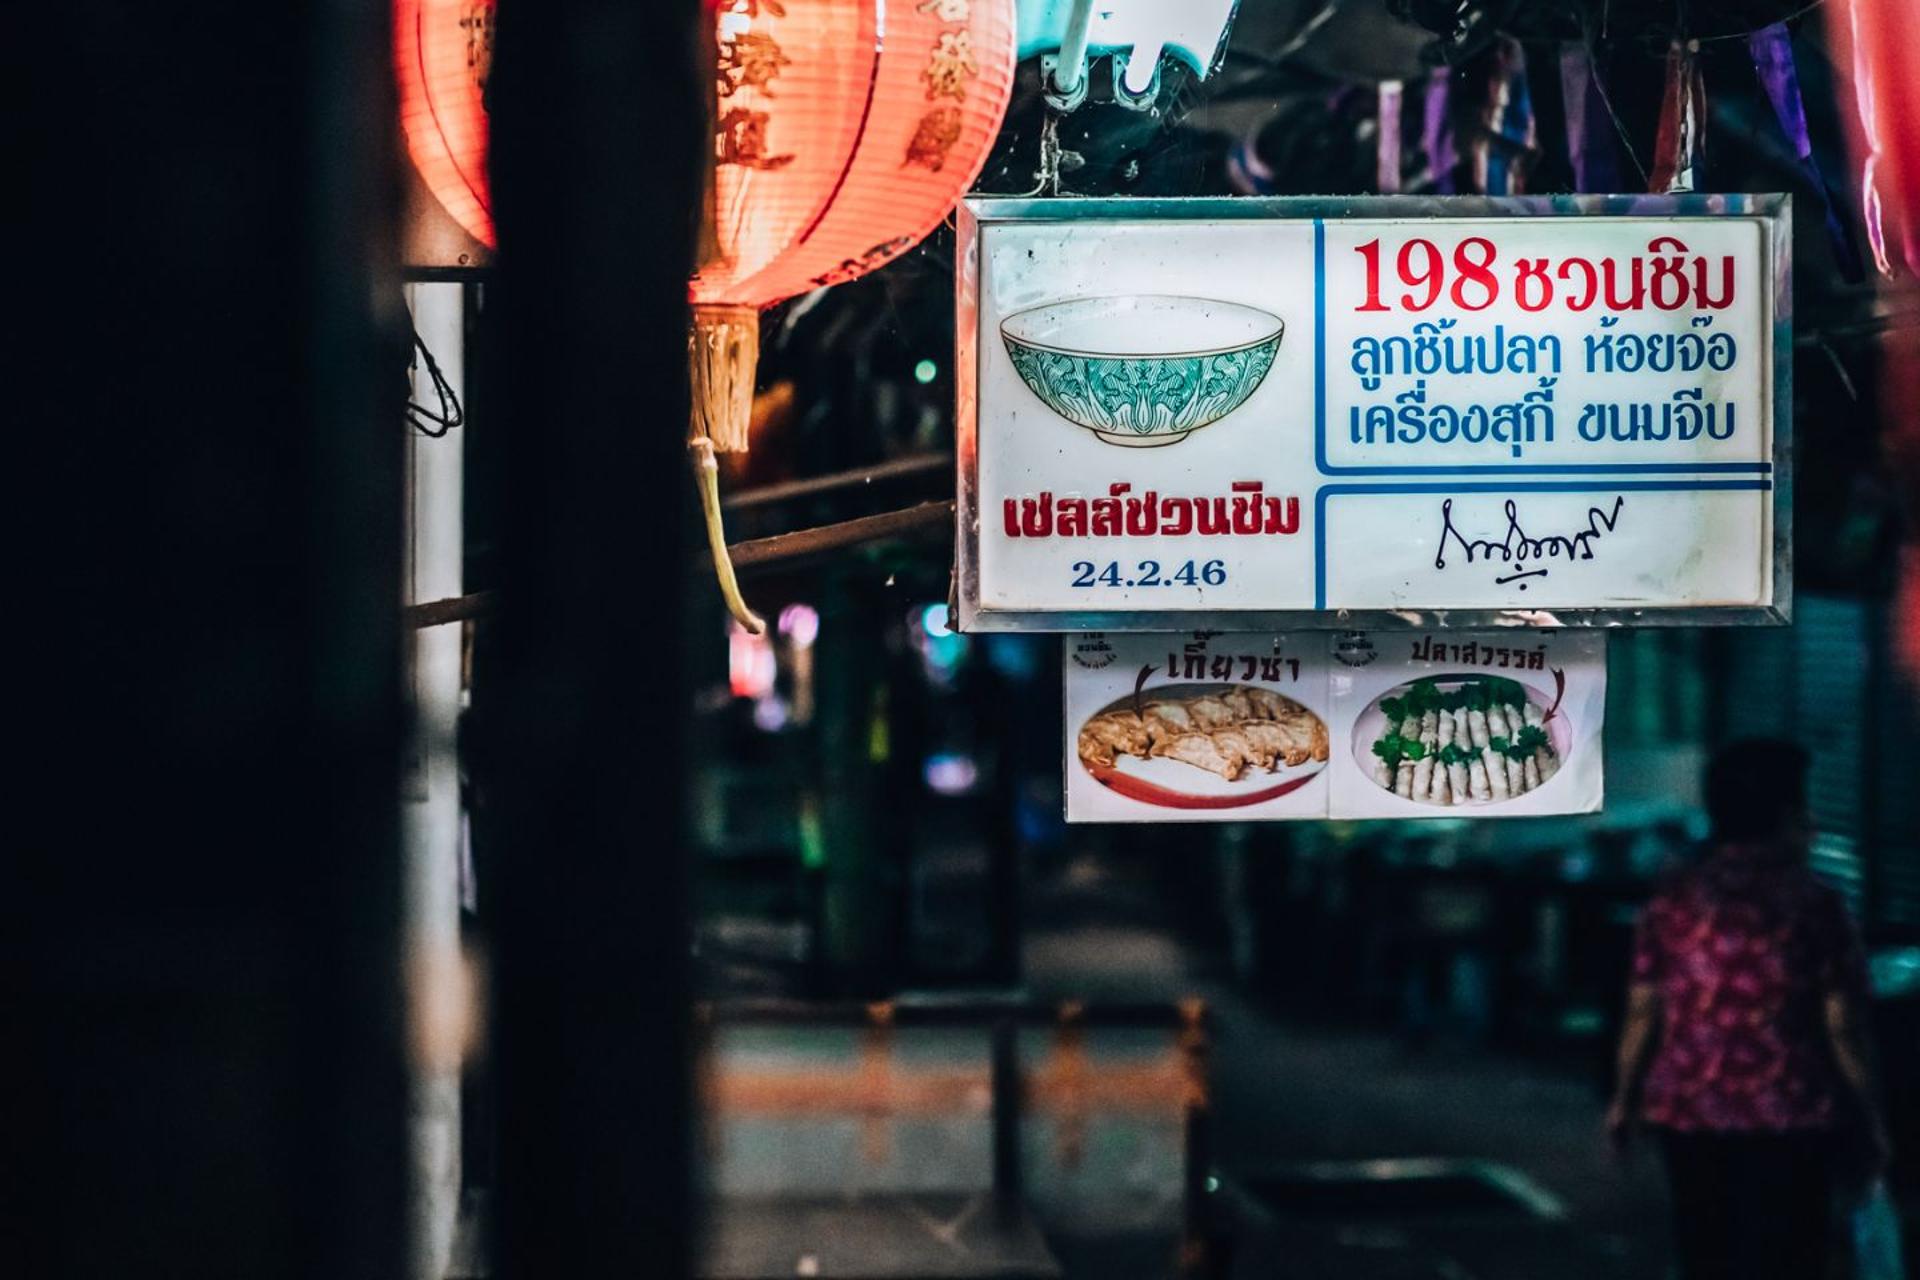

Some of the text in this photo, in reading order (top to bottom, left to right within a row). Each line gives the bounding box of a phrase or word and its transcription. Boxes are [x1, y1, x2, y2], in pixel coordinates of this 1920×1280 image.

[1354, 237, 1735, 313] 198 ชวนชิม
[1350, 315, 1737, 392] ลูกชิ้นปลา ห้อยจ๊อ
[1349, 376, 1735, 459] เครื่องสุกี้ ขนมจีบ
[1003, 481, 1300, 538] เชลล์ชวนชิม
[1071, 559, 1227, 588] 24.2.46
[1411, 635, 1549, 670] ปลาสวรรค์
